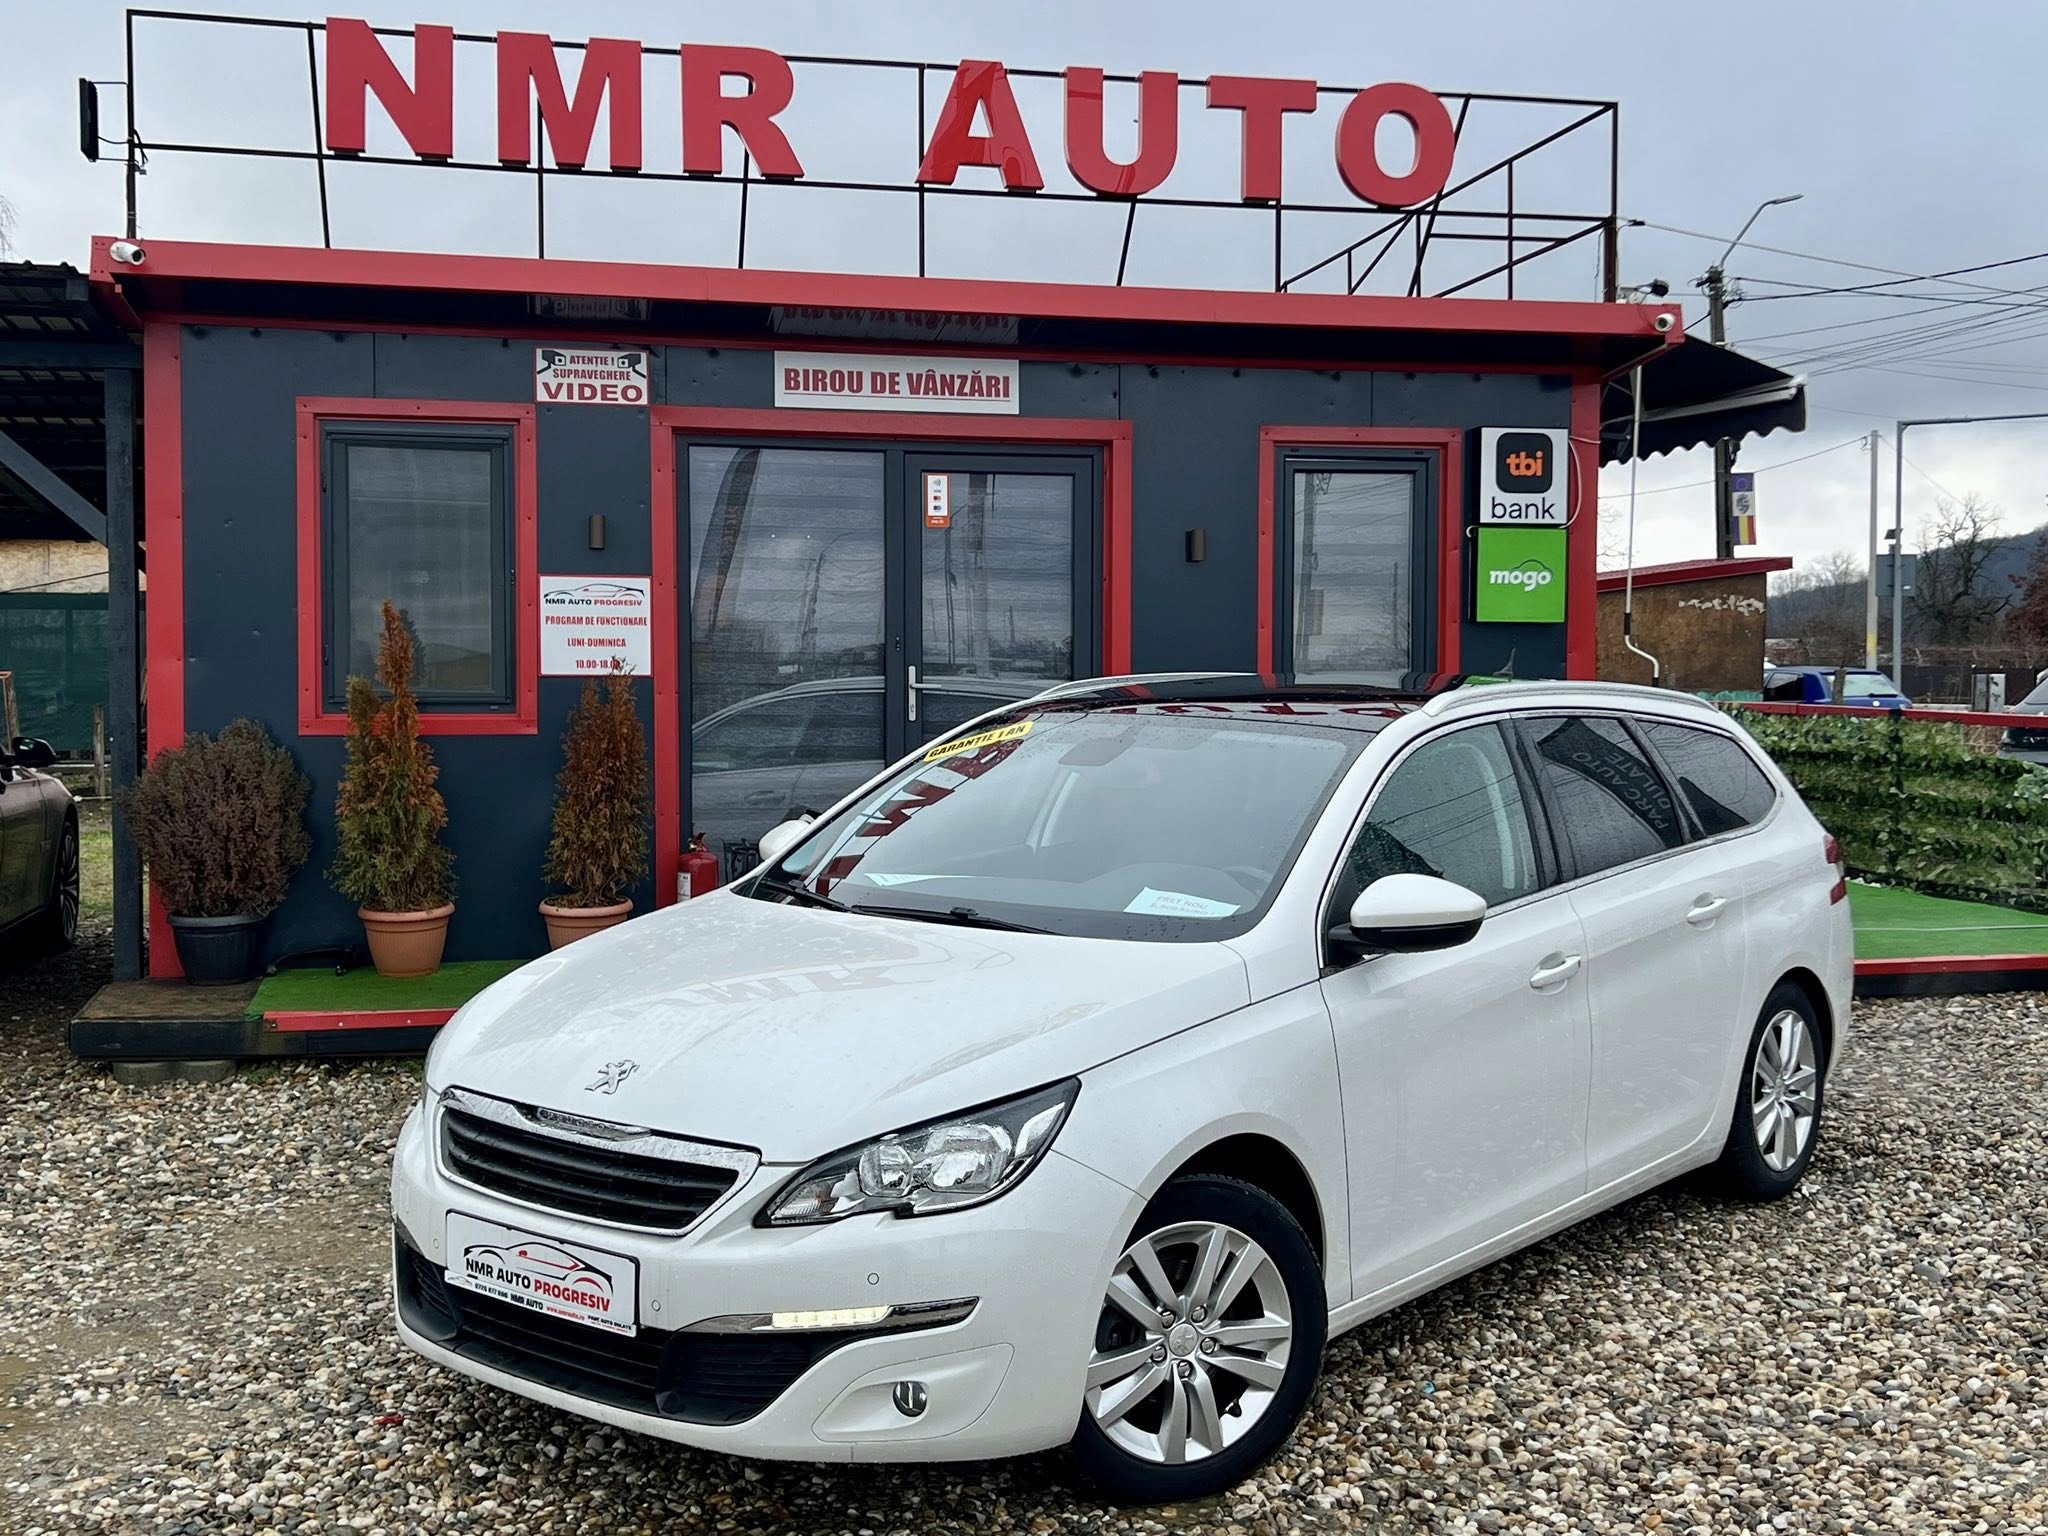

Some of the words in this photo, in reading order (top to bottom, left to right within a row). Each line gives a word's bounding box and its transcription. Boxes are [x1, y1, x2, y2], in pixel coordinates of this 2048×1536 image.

[326, 17, 805, 178] NMR
[915, 60, 1455, 207] AUTO
[552, 368, 631, 381] SUPRAVEGHERE
[784, 368, 864, 393] BIROU
[870, 371, 901, 394] DE
[906, 368, 1010, 398] VÂNZĂRI
[542, 382, 643, 403] VIDEO
[1506, 450, 1544, 477] tbi
[1491, 496, 1555, 520] bank
[1489, 570, 1552, 592] mogo
[545, 616, 583, 625] PROGRAM
[585, 616, 594, 625] DE
[567, 638, 627, 647] LUNI-DUMINICA
[929, 734, 993, 757] GARANTIE
[1006, 725, 1026, 737] AN
[466, 1257, 493, 1277] NMR
[496, 1268, 530, 1289] AUTO
[534, 1279, 611, 1312] PROGRESIV
[510, 1293, 524, 1304] NMR
[526, 1298, 544, 1310] AUTO
